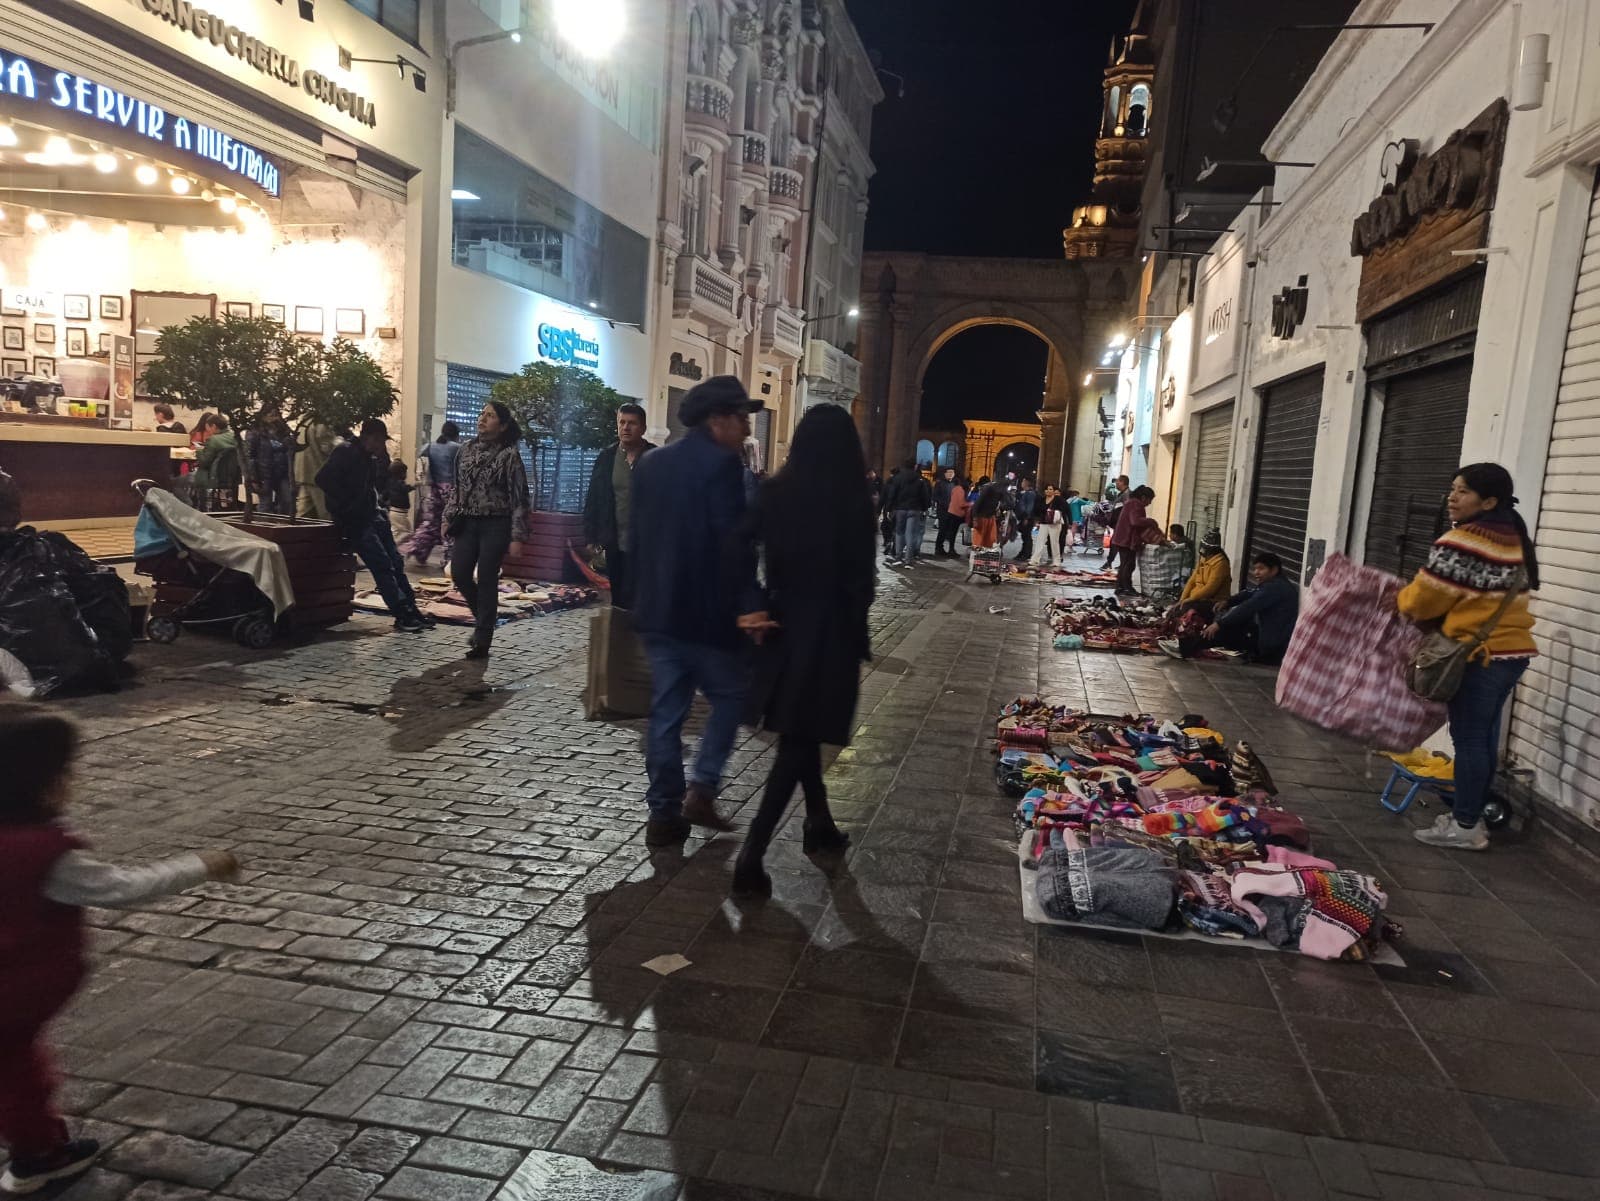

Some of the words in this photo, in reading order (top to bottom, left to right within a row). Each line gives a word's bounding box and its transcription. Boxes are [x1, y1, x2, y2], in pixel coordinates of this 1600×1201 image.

[302, 69, 377, 129] CRIOLLA
[51, 71, 165, 141] SERVIR
[174, 116, 191, 150] A
[197, 123, 263, 184] NUESTRA
[15, 294, 45, 308] CAJA
[538, 322, 572, 362] SBS
